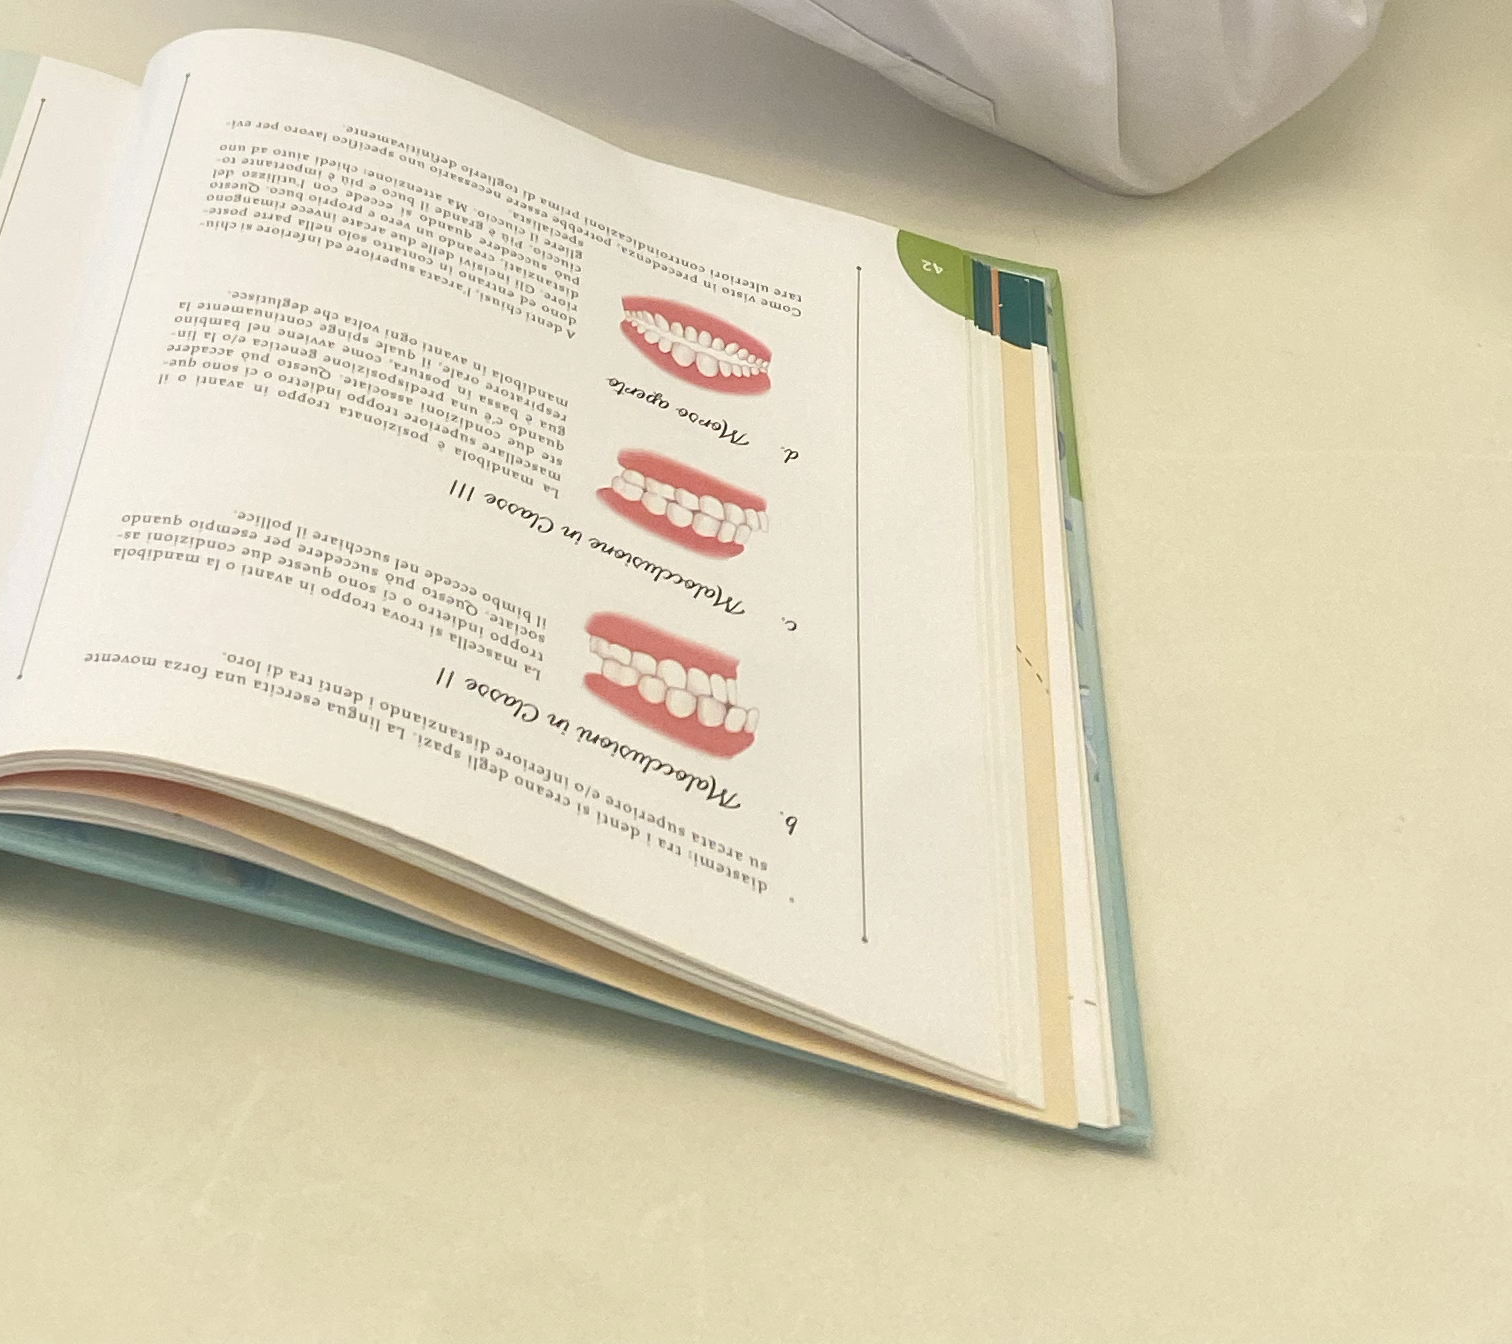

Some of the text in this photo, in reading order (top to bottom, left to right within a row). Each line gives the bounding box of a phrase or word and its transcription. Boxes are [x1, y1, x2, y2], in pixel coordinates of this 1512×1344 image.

[920, 257, 944, 275] 42
[604, 375, 750, 446] Morso aperto
[447, 477, 746, 615] Malocclusione in Classe III
[82, 651, 157, 666] movente
[162, 658, 208, 680] forza
[213, 668, 246, 685] una
[252, 677, 321, 706] esercita
[325, 699, 381, 732] lingua
[385, 721, 405, 740] La
[411, 730, 461, 759] spazi.
[434, 665, 741, 809] Malocclusioni in Classe II
[466, 752, 509, 782] degli
[512, 773, 571, 806] creano
[575, 800, 590, 816] si
[595, 809, 640, 840] denti
[656, 835, 681, 856] tra
[686, 848, 767, 894] diastemi:
